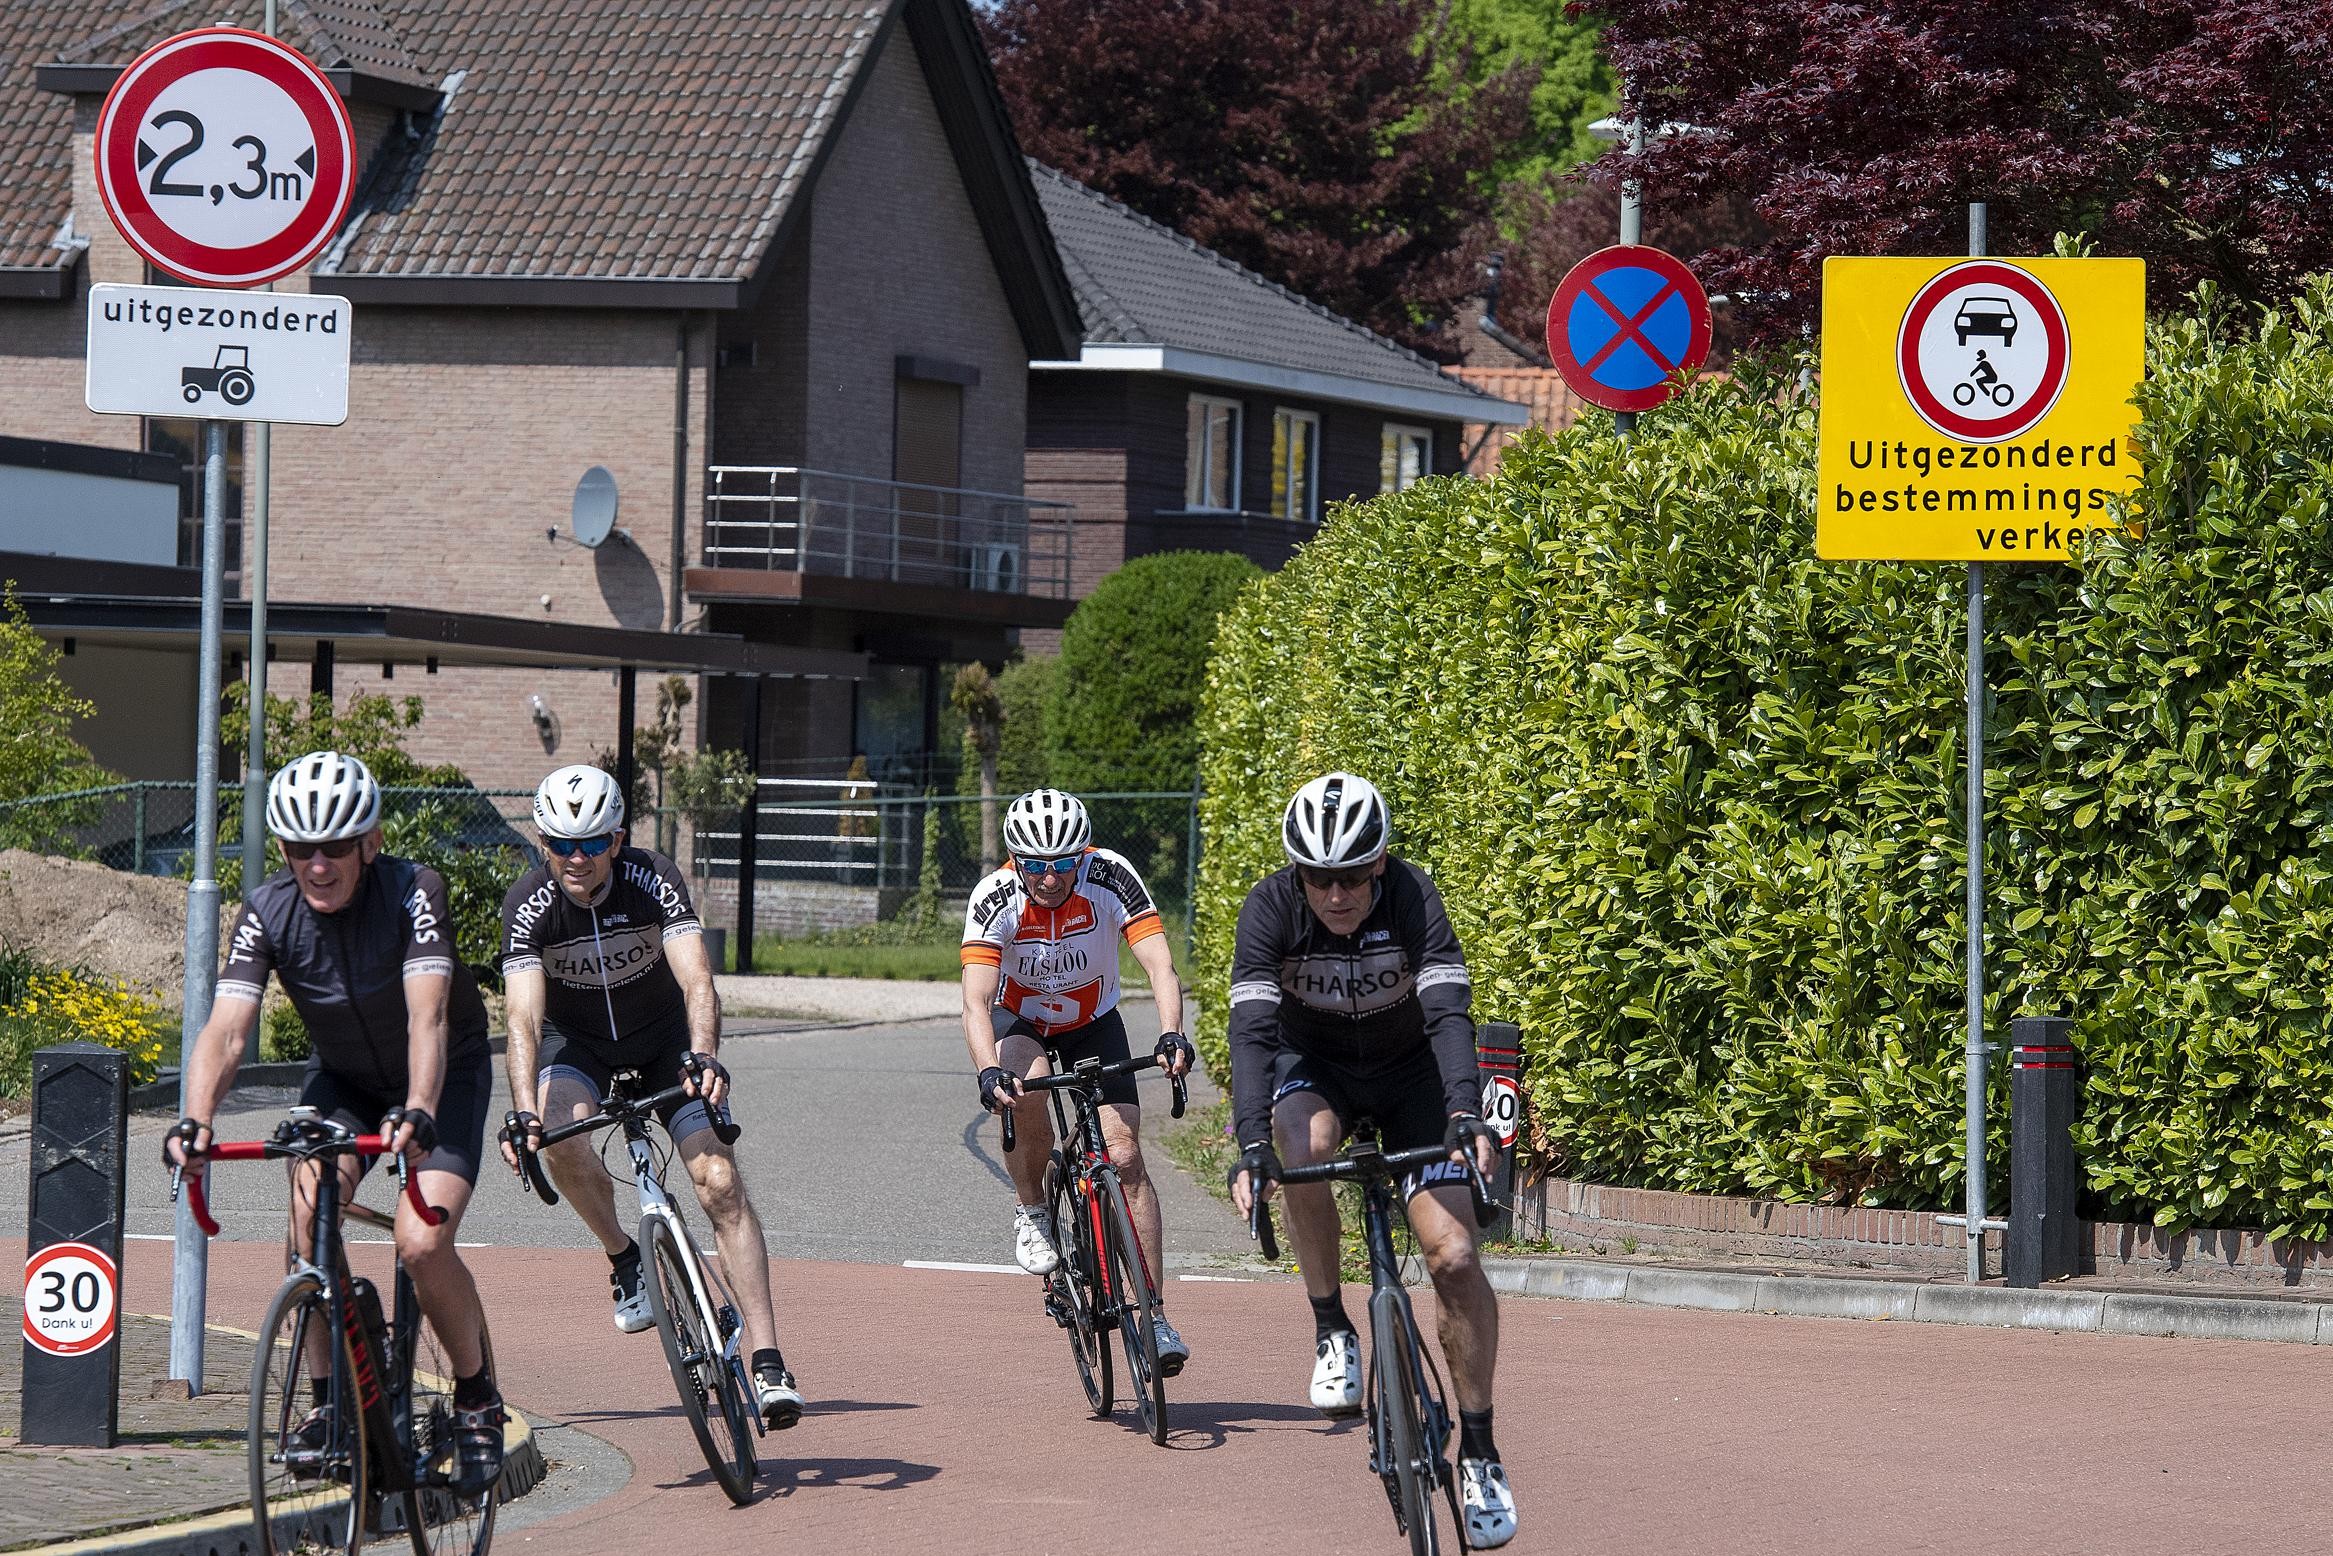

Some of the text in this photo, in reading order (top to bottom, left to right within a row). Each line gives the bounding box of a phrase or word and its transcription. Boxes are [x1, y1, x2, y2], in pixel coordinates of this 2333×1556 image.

[104, 298, 337, 334] uitgezonderd
[1849, 438, 2117, 478] Uitgezonderd
[1836, 482, 2105, 519] bestemmings
[1018, 949, 1088, 977] ELSLOO
[1031, 942, 1074, 958] KASTEEL
[1039, 974, 1067, 982] HOTEL
[1503, 1123, 1511, 1132] u!
[39, 1271, 100, 1313] 30
[42, 1317, 93, 1329] Dank u!
